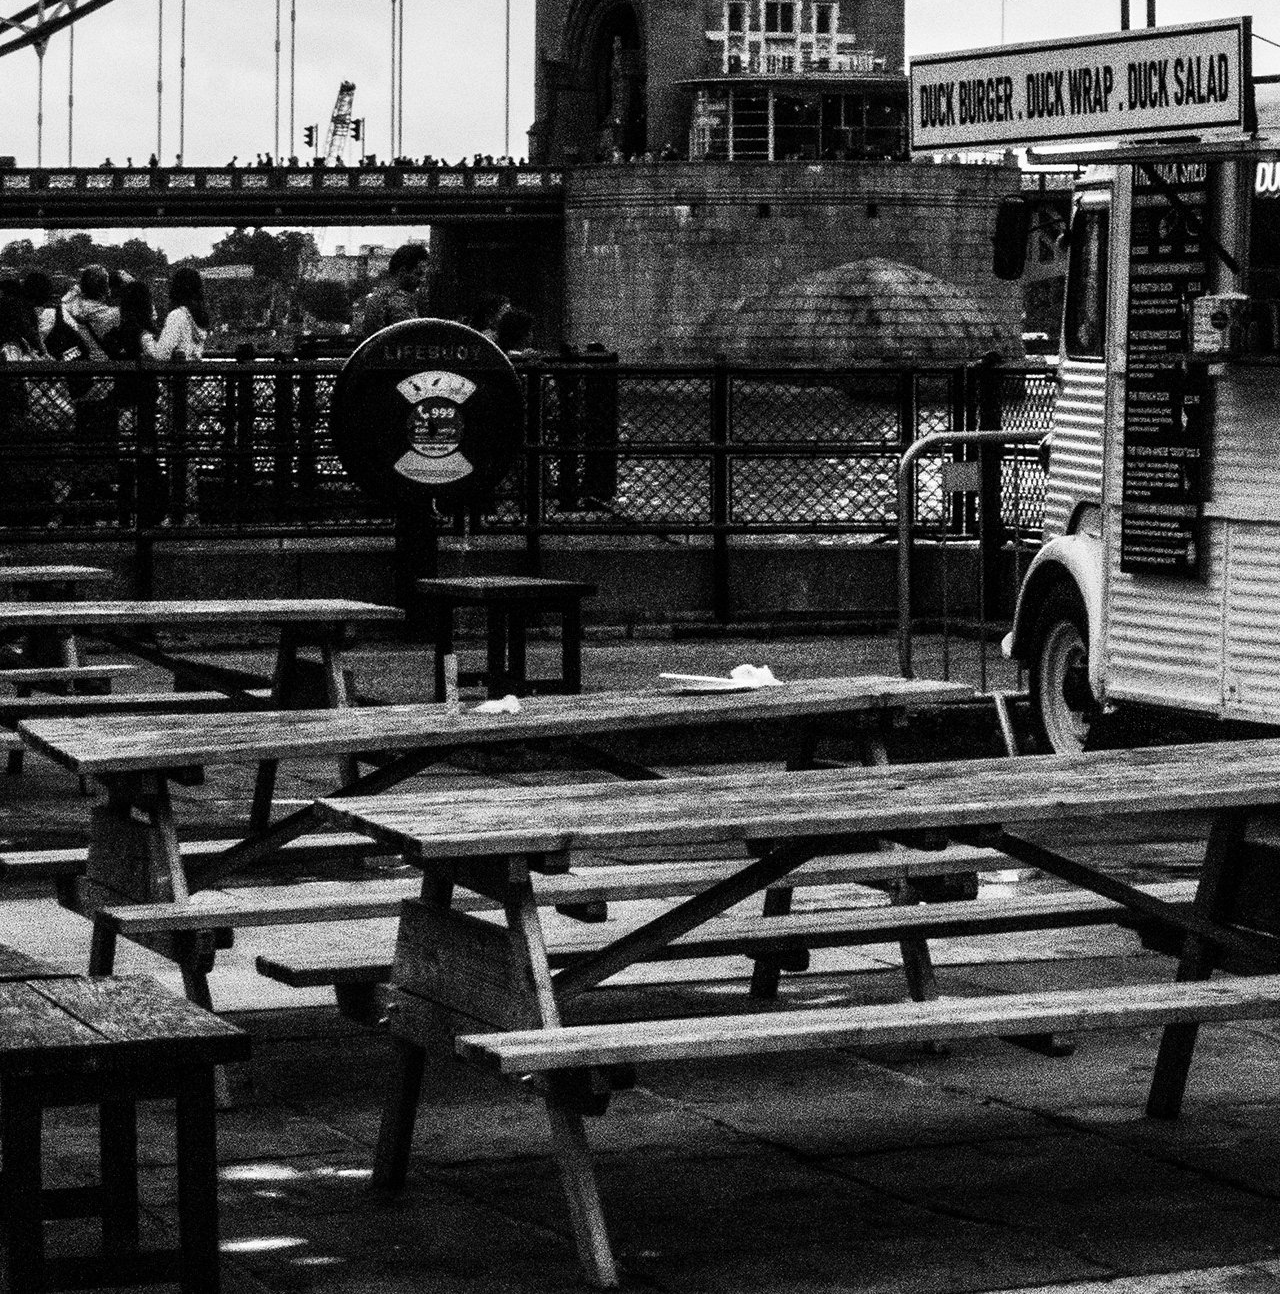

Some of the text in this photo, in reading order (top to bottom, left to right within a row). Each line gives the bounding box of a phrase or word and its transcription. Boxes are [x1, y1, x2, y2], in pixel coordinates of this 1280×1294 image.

[920, 53, 1229, 128] DUCK BURGER DUCK WRAP DUCK SALAD
[383, 344, 482, 361] LIFEBUOY
[431, 407, 456, 419] 999
